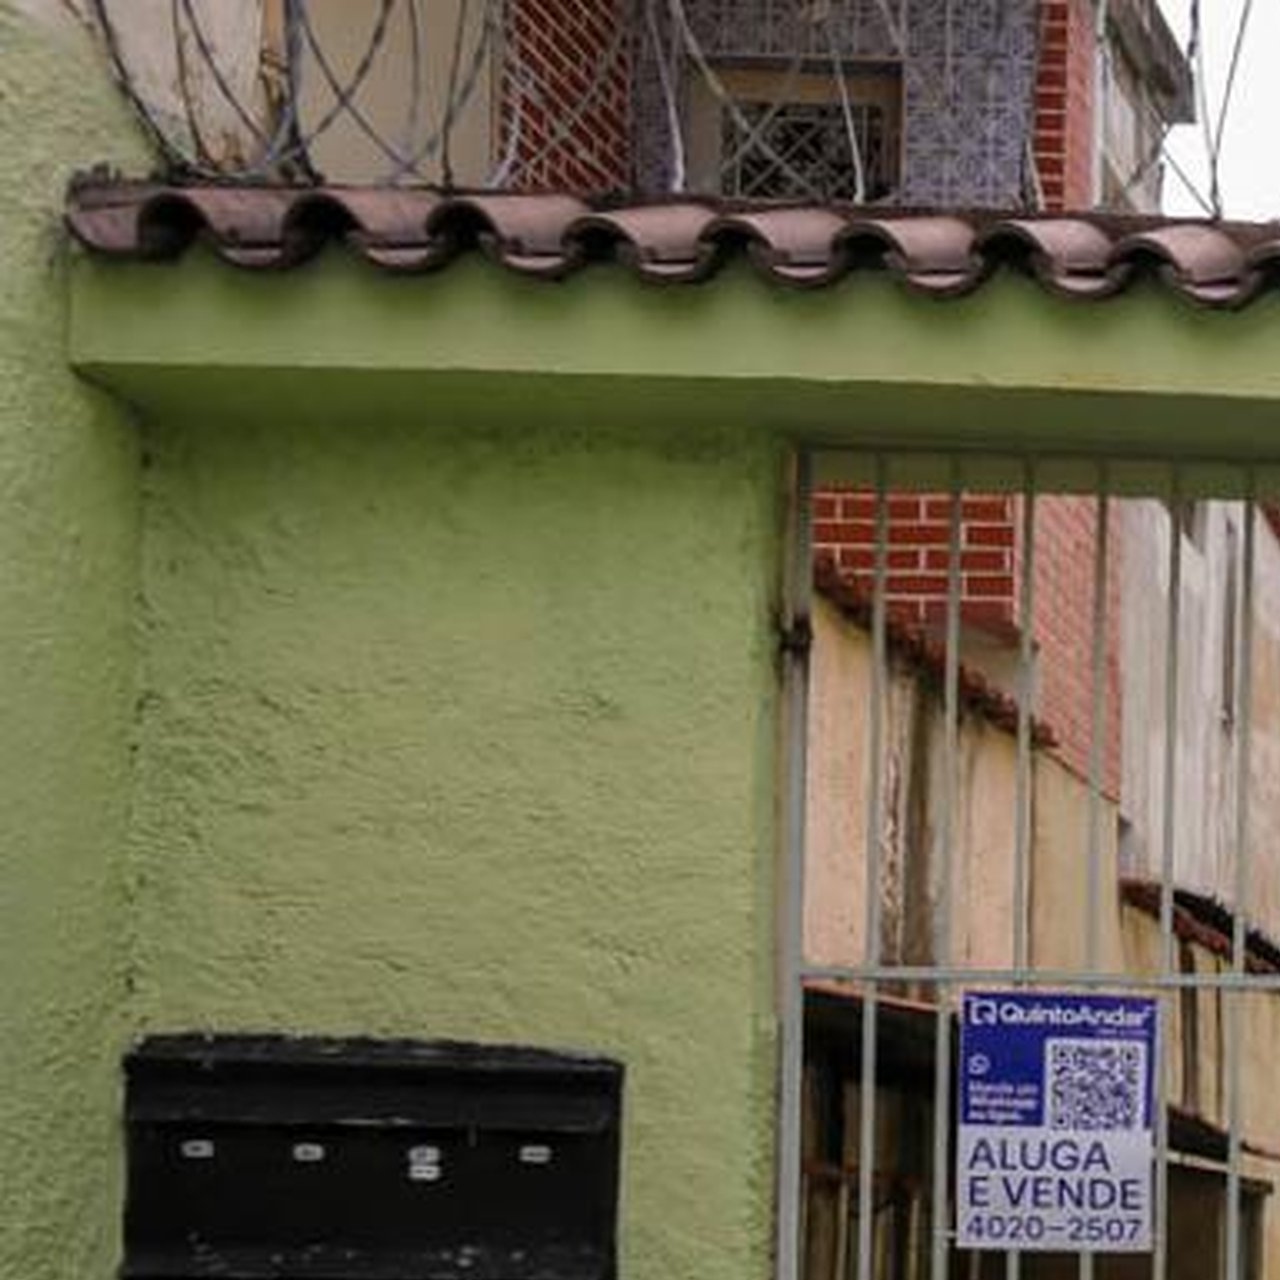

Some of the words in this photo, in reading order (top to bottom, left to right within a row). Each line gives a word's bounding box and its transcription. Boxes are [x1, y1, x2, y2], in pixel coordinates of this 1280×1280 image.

[1000, 1002, 1149, 1026] QuintoAndar
[968, 1138, 1110, 1172] ALUGA
[968, 1176, 989, 1207] E
[1002, 1177, 1143, 1210] VENDE
[966, 1215, 1143, 1241] 4020-2507
